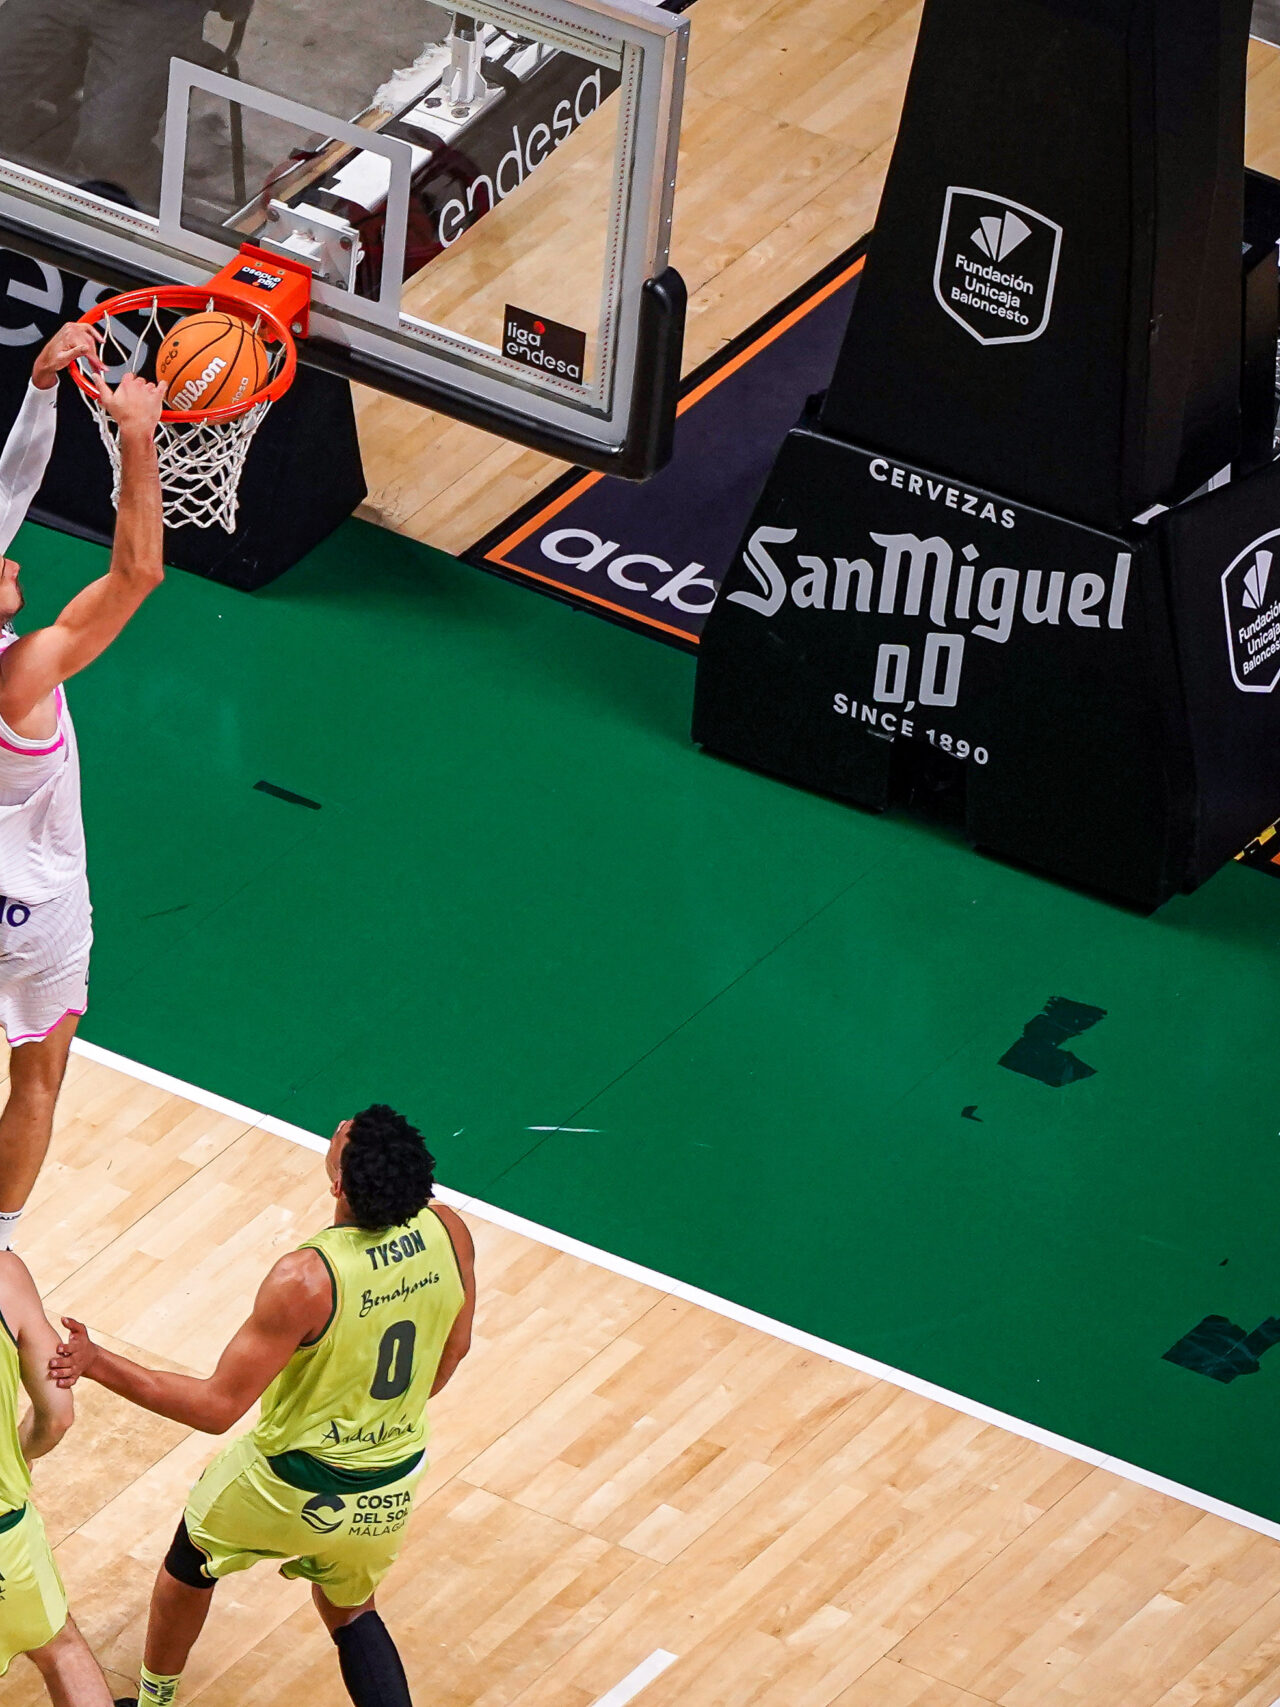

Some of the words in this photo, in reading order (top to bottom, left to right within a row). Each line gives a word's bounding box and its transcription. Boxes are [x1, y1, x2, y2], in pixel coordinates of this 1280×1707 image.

[439, 68, 601, 248] endesa
[955, 254, 1034, 295] Fundación
[964, 275, 1021, 308] Unicaja
[951, 287, 1029, 325] Baloncesto
[507, 321, 541, 347] liga
[506, 340, 580, 379] endesa
[172, 356, 227, 411] Wilson
[869, 458, 1017, 529] CERVEZAS
[539, 527, 718, 614] acb
[873, 632, 966, 708] 0,0
[1243, 638, 1280, 676] Balonces
[832, 693, 915, 737] SINCE
[925, 729, 989, 765] 1890
[365, 1229, 427, 1271] TYSON
[369, 1319, 417, 1401] 0
[352, 1512, 383, 1524] DEL
[356, 1490, 411, 1510] COSTA
